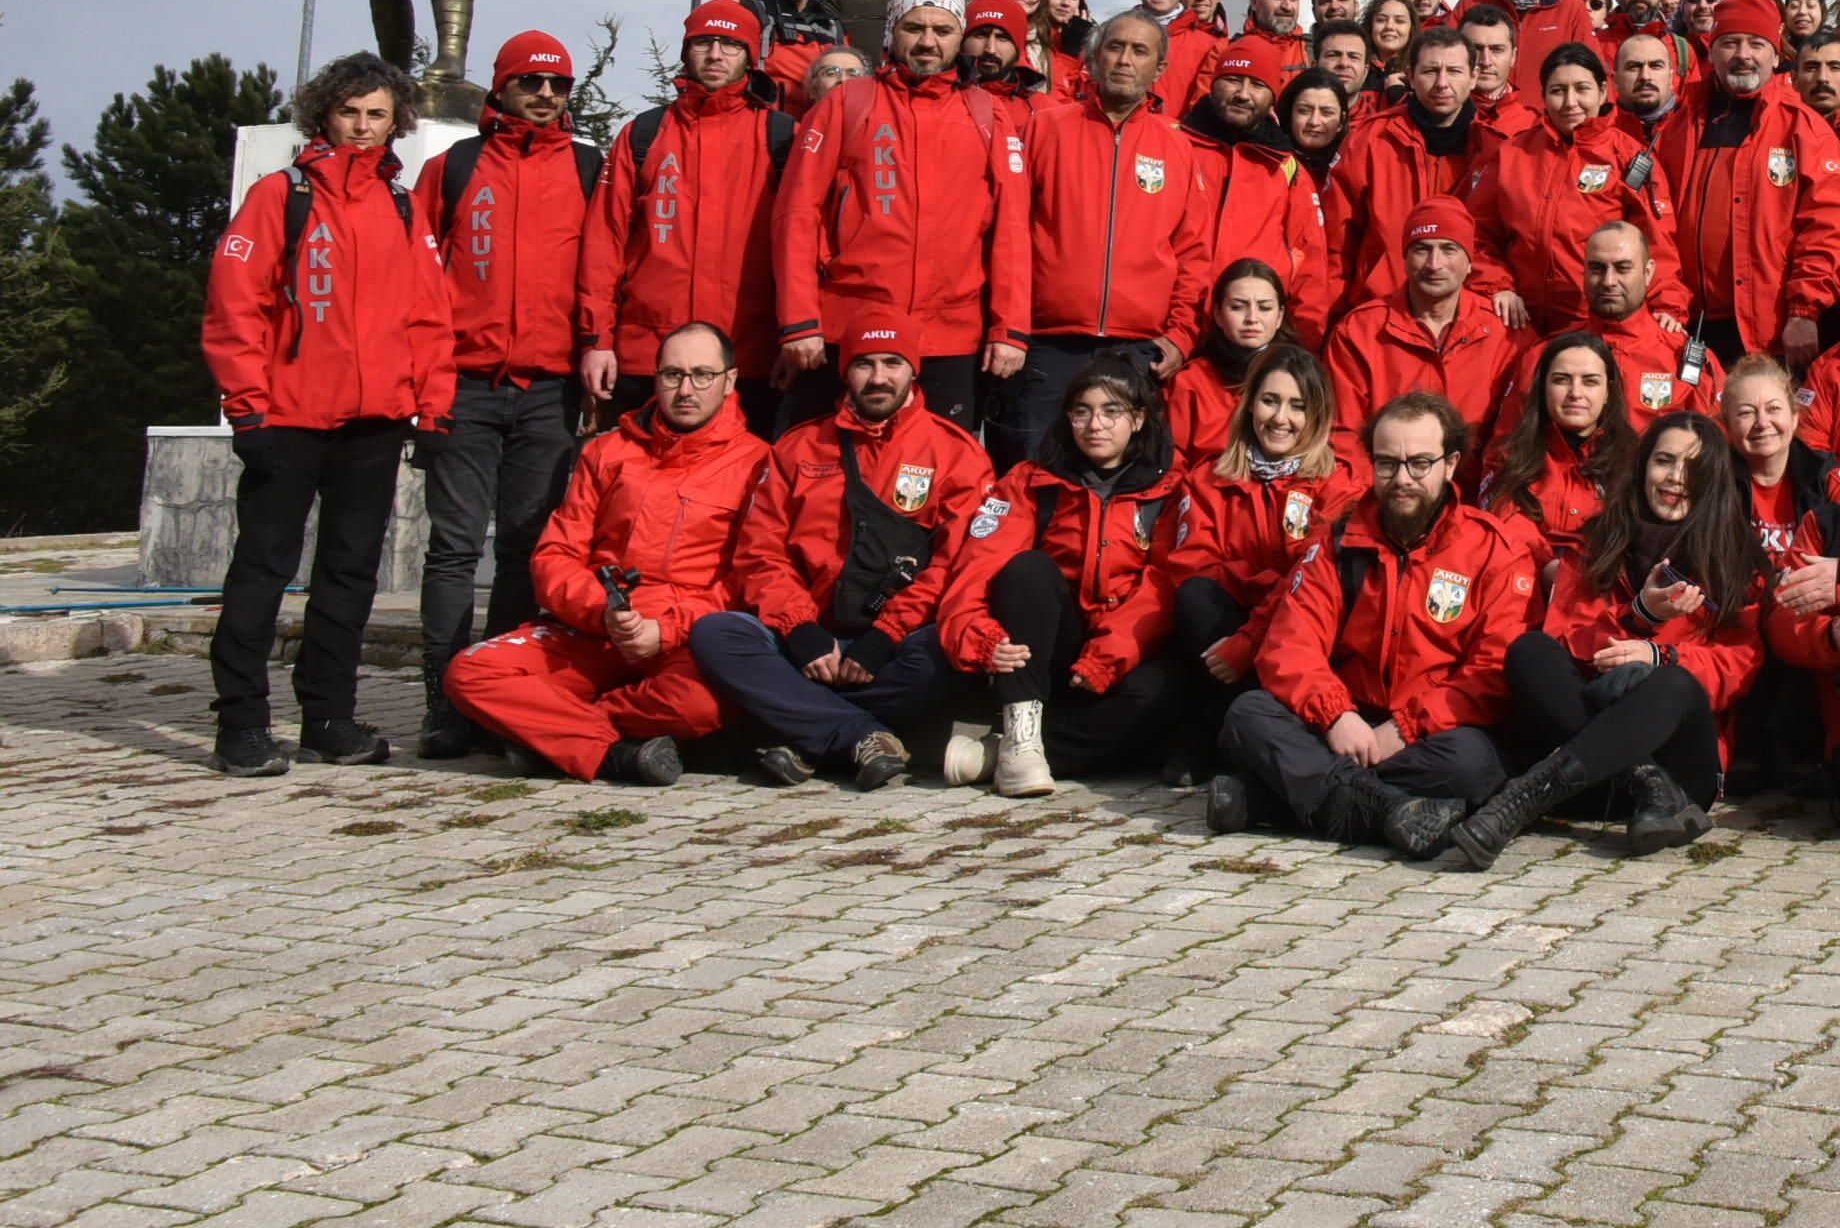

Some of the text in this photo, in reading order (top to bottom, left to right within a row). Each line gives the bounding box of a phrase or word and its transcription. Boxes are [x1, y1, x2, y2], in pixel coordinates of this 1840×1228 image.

[976, 11, 1005, 21] AKUT
[705, 19, 738, 31] AKUT
[529, 53, 561, 64] AKUT
[1222, 59, 1252, 69] AKUT
[873, 124, 897, 214] AKUT
[654, 152, 681, 244] AKUT
[472, 186, 497, 280] AKUT
[1410, 224, 1438, 237] AKUT
[308, 222, 335, 322] AKUT
[861, 330, 897, 340] AKUT
[1643, 372, 1672, 380] AKUT
[901, 465, 934, 476] AKUT
[984, 502, 1007, 515] KUT
[1435, 570, 1469, 586] AKUT
